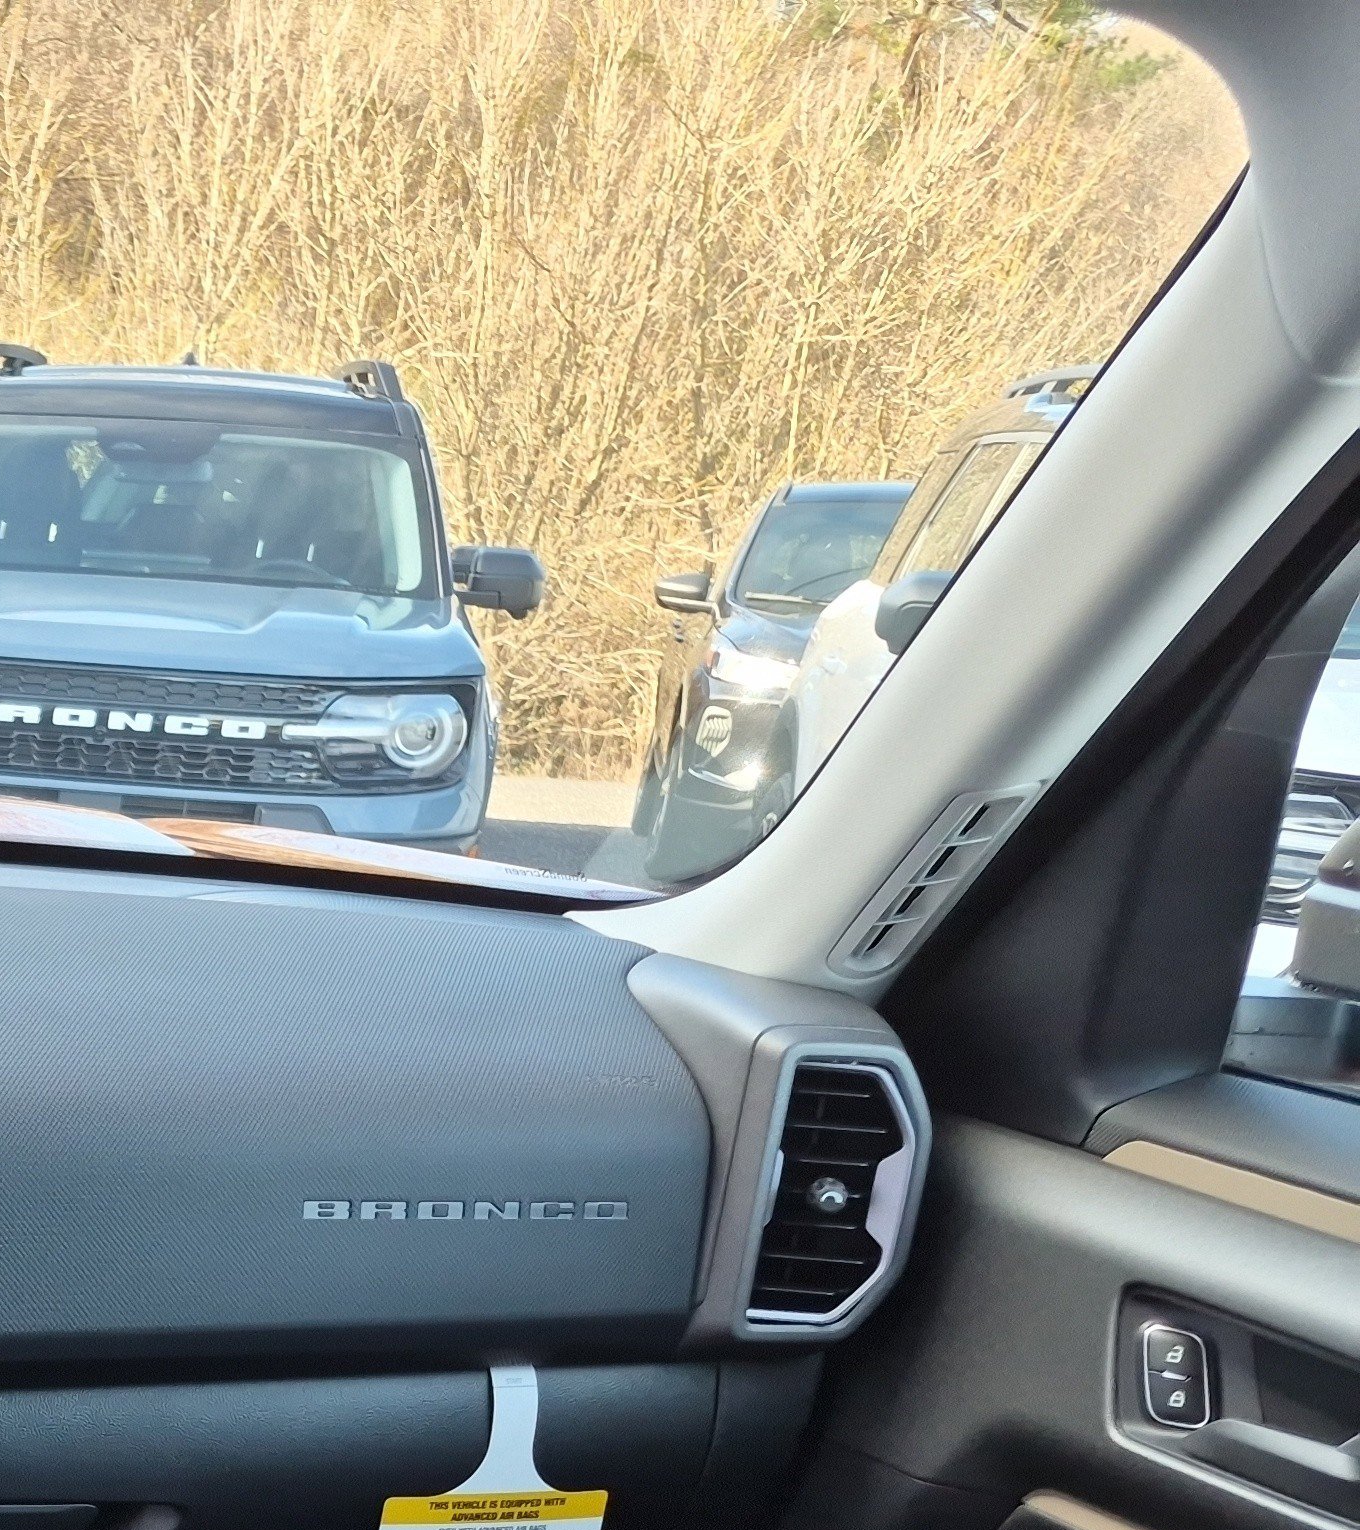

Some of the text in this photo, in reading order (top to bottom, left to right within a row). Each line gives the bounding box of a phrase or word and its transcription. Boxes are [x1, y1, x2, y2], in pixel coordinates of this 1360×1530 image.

[302, 1200, 629, 1220] BRONCO
[451, 1500, 487, 1510] VEHICLE
[489, 1500, 498, 1509] IS
[500, 1498, 541, 1509] EQUIPPED
[544, 1497, 566, 1506] WITH
[450, 1512, 497, 1521] ADVANCED
[516, 1510, 540, 1519] BAGS
